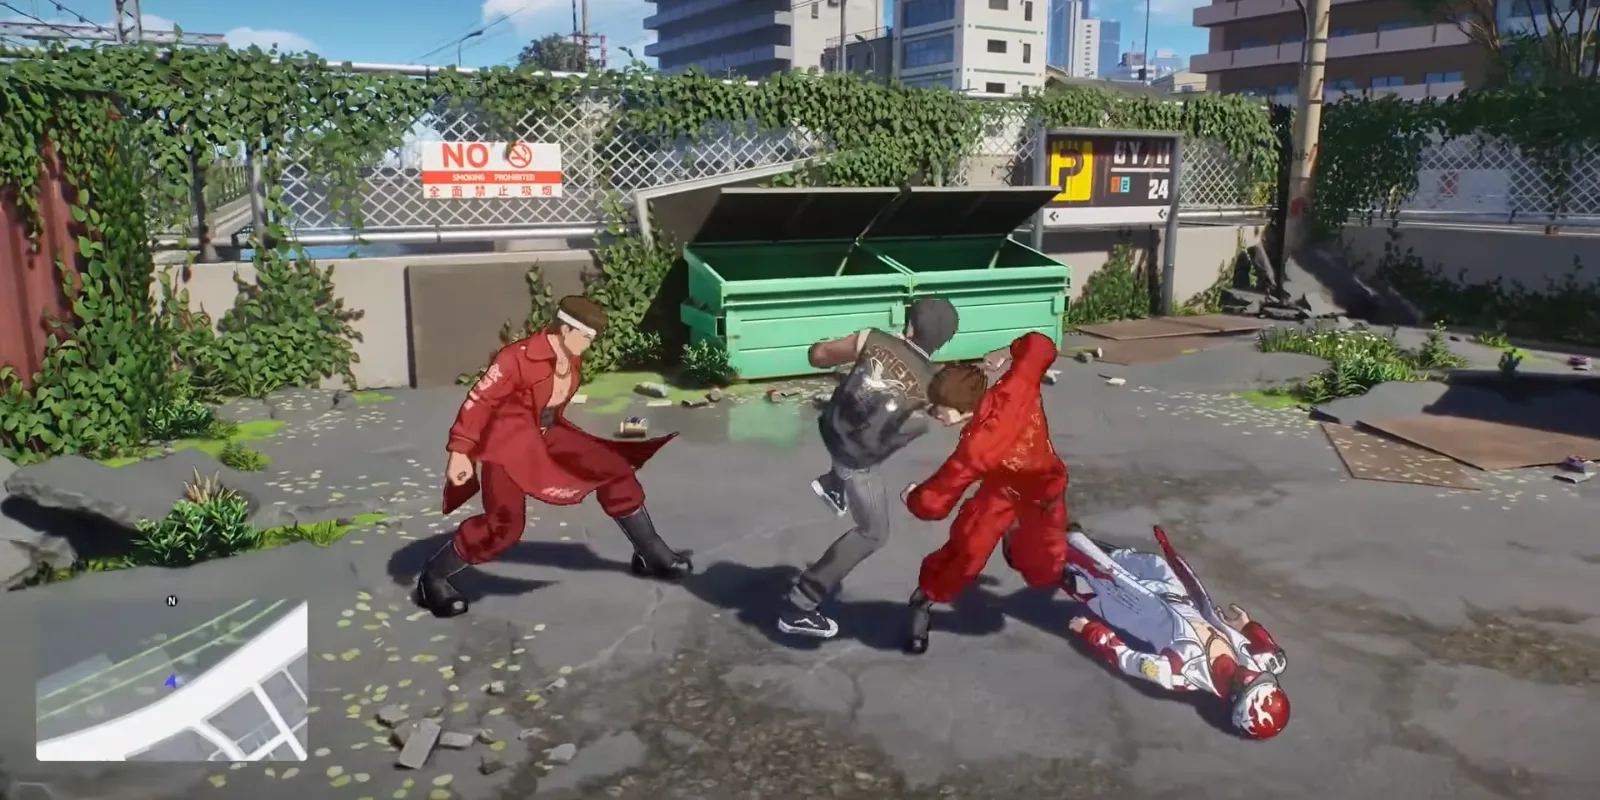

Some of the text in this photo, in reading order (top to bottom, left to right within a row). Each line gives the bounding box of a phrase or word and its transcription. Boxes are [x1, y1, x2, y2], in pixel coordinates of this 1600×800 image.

[442, 143, 489, 168] NO
[452, 173, 535, 181] SMOKING PROHIBITED
[1058, 149, 1084, 193] P
[429, 185, 553, 197] 全面禁止吸烟
[1148, 179, 1169, 200] 24
